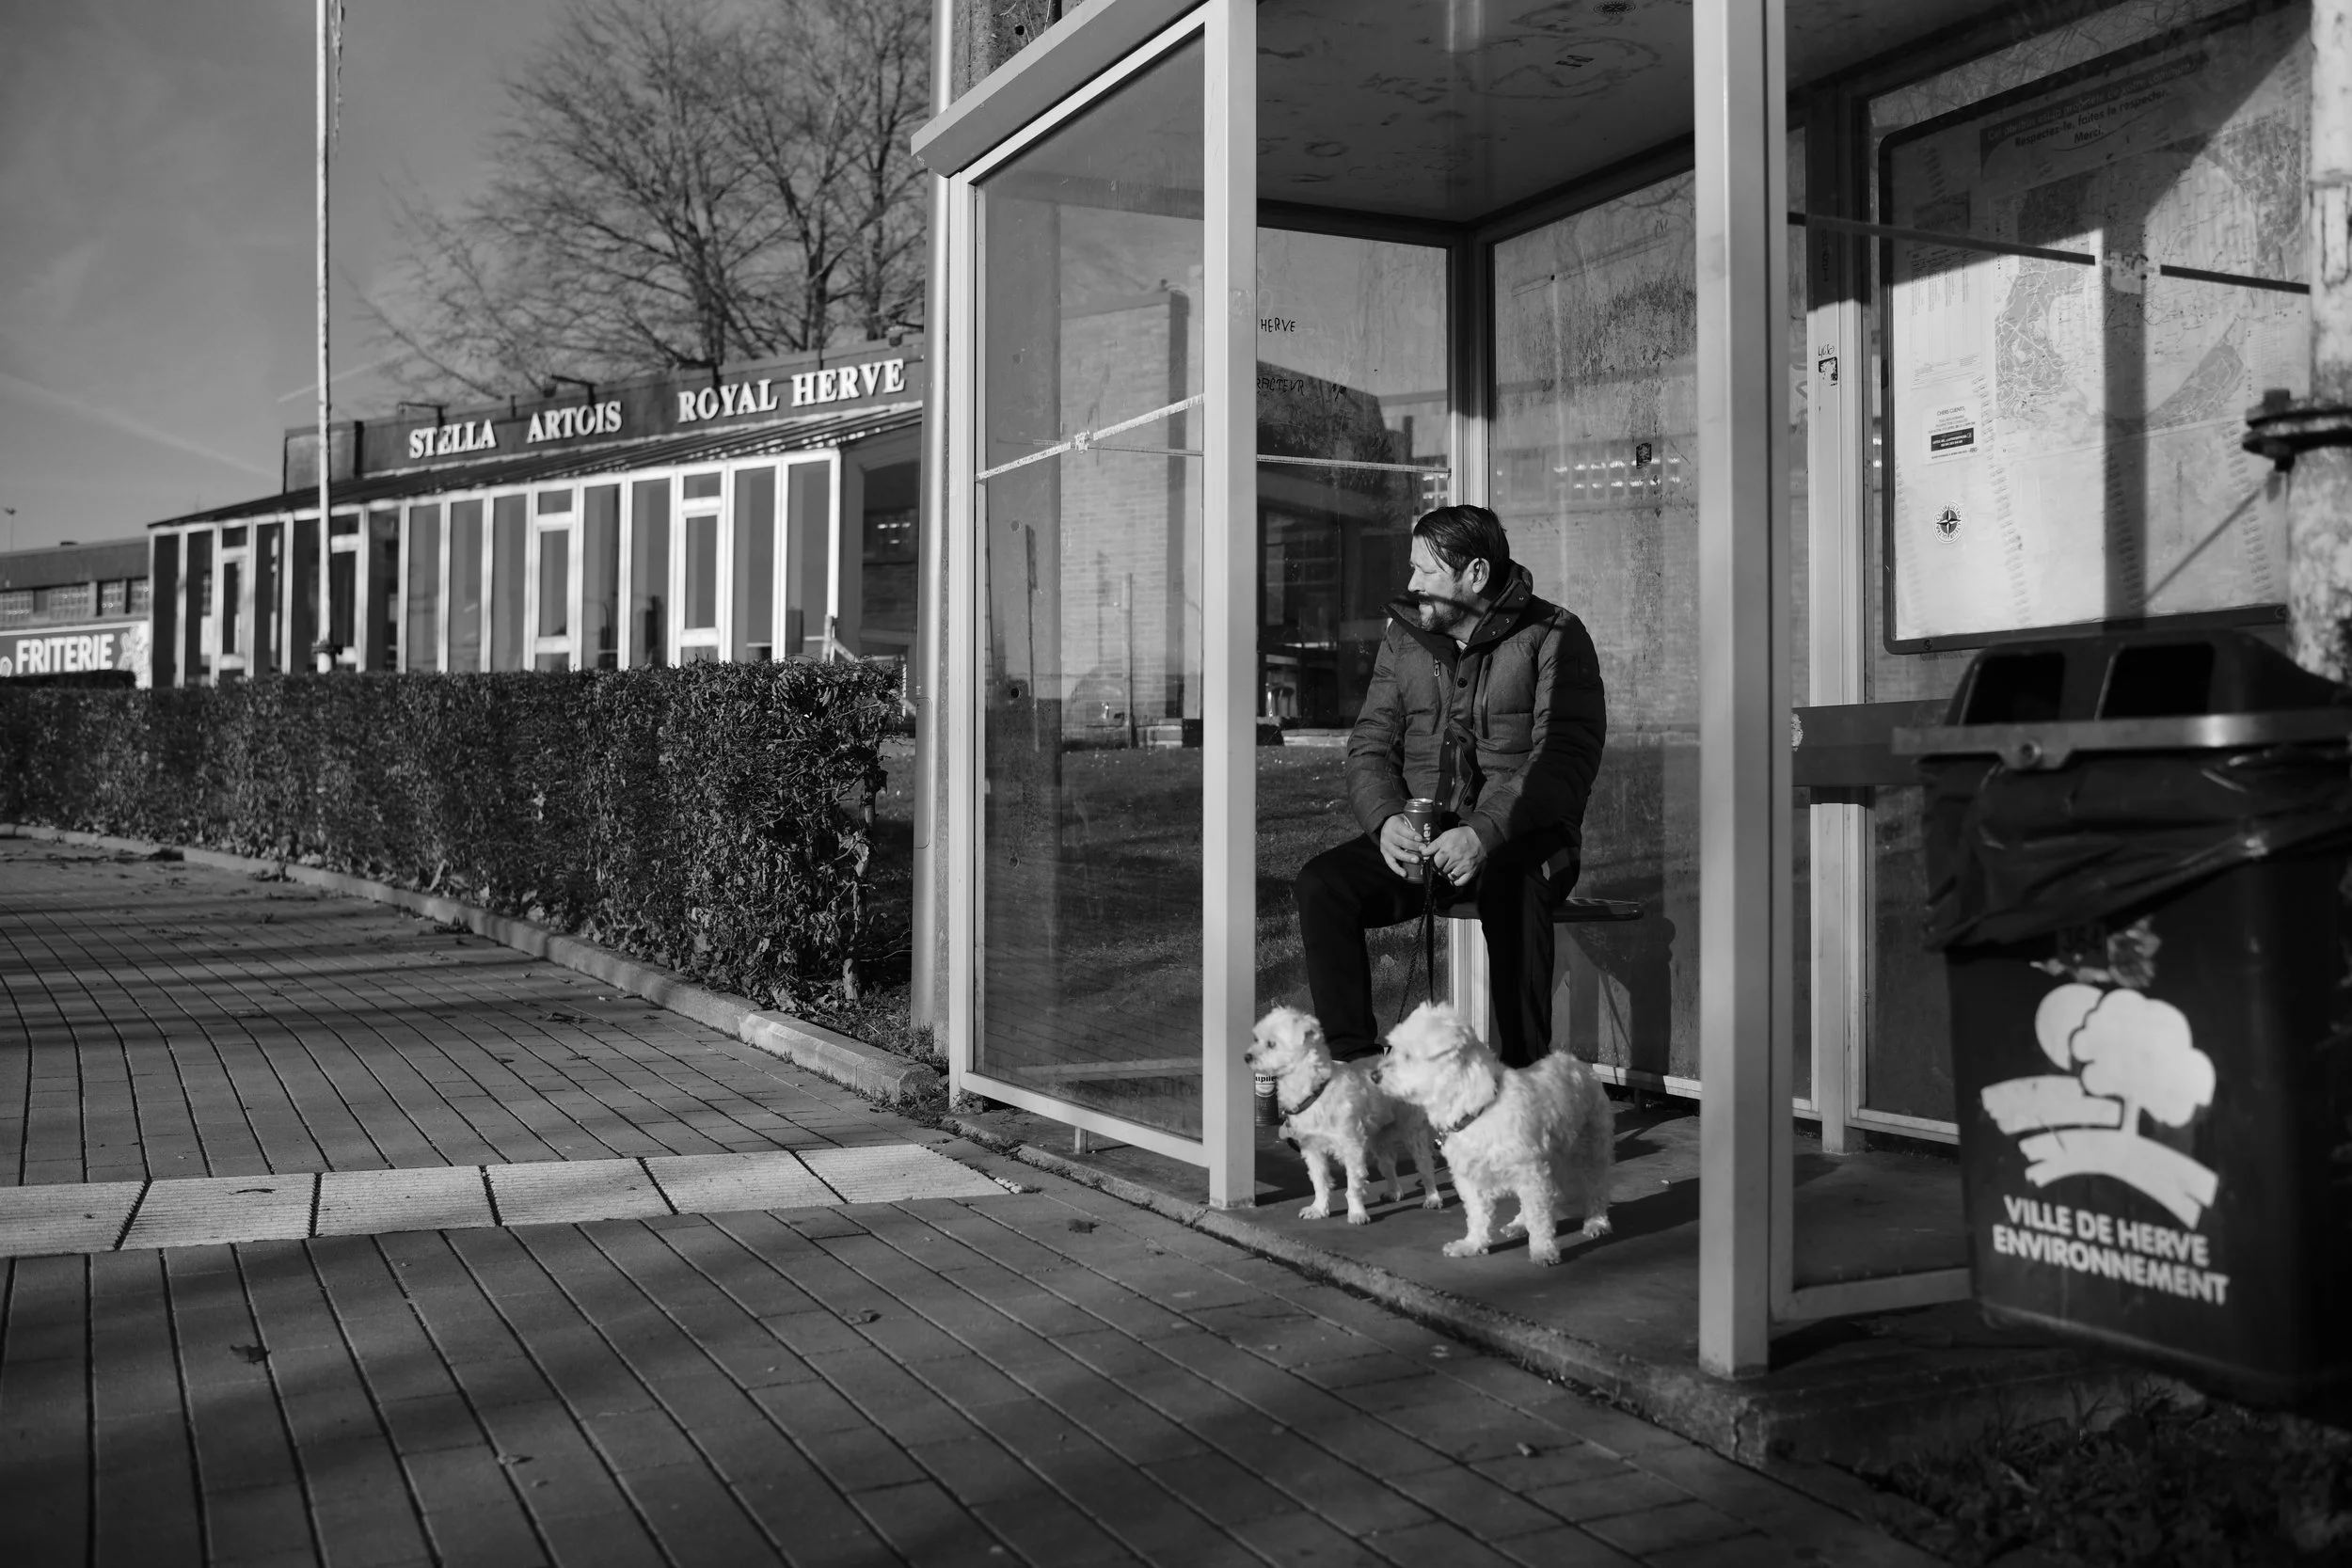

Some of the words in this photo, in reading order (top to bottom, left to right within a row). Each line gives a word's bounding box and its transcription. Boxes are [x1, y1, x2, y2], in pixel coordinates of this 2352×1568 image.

[2077, 110, 2105, 126] faites
[1260, 317, 1296, 333] HERVE
[677, 378, 779, 423] ROYAL
[791, 357, 906, 407] HERVE
[408, 419, 498, 459] STELLA
[526, 400, 623, 444] ARTOIS
[15, 633, 115, 674] FRITERIE
[2003, 1195, 2073, 1235] VILLE
[2075, 1210, 2114, 1245] DE
[2117, 1218, 2210, 1267] HERVE
[1992, 1225, 2231, 1307] ENVIRONNEMENT
